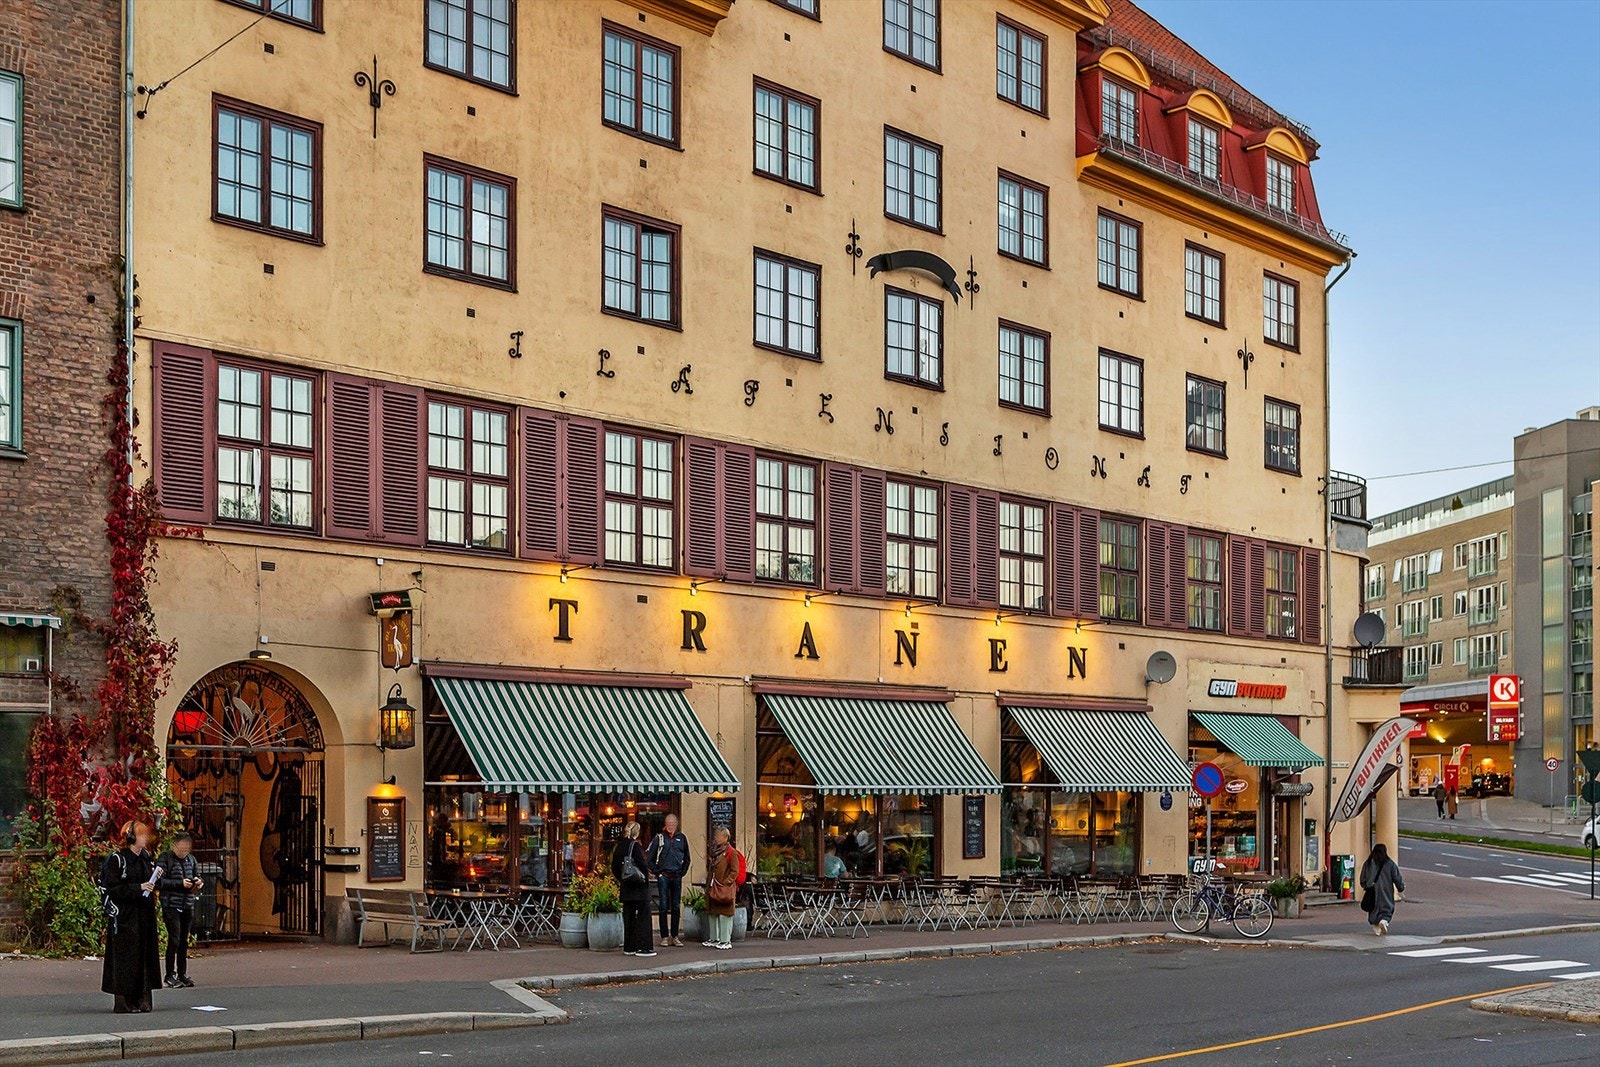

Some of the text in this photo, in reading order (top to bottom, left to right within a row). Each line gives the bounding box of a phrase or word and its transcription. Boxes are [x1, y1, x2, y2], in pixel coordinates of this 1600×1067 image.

[548, 598, 1089, 679] TRANEN
[1433, 703, 1458, 711] CIRCLE
[1547, 761, 1557, 769] 40
